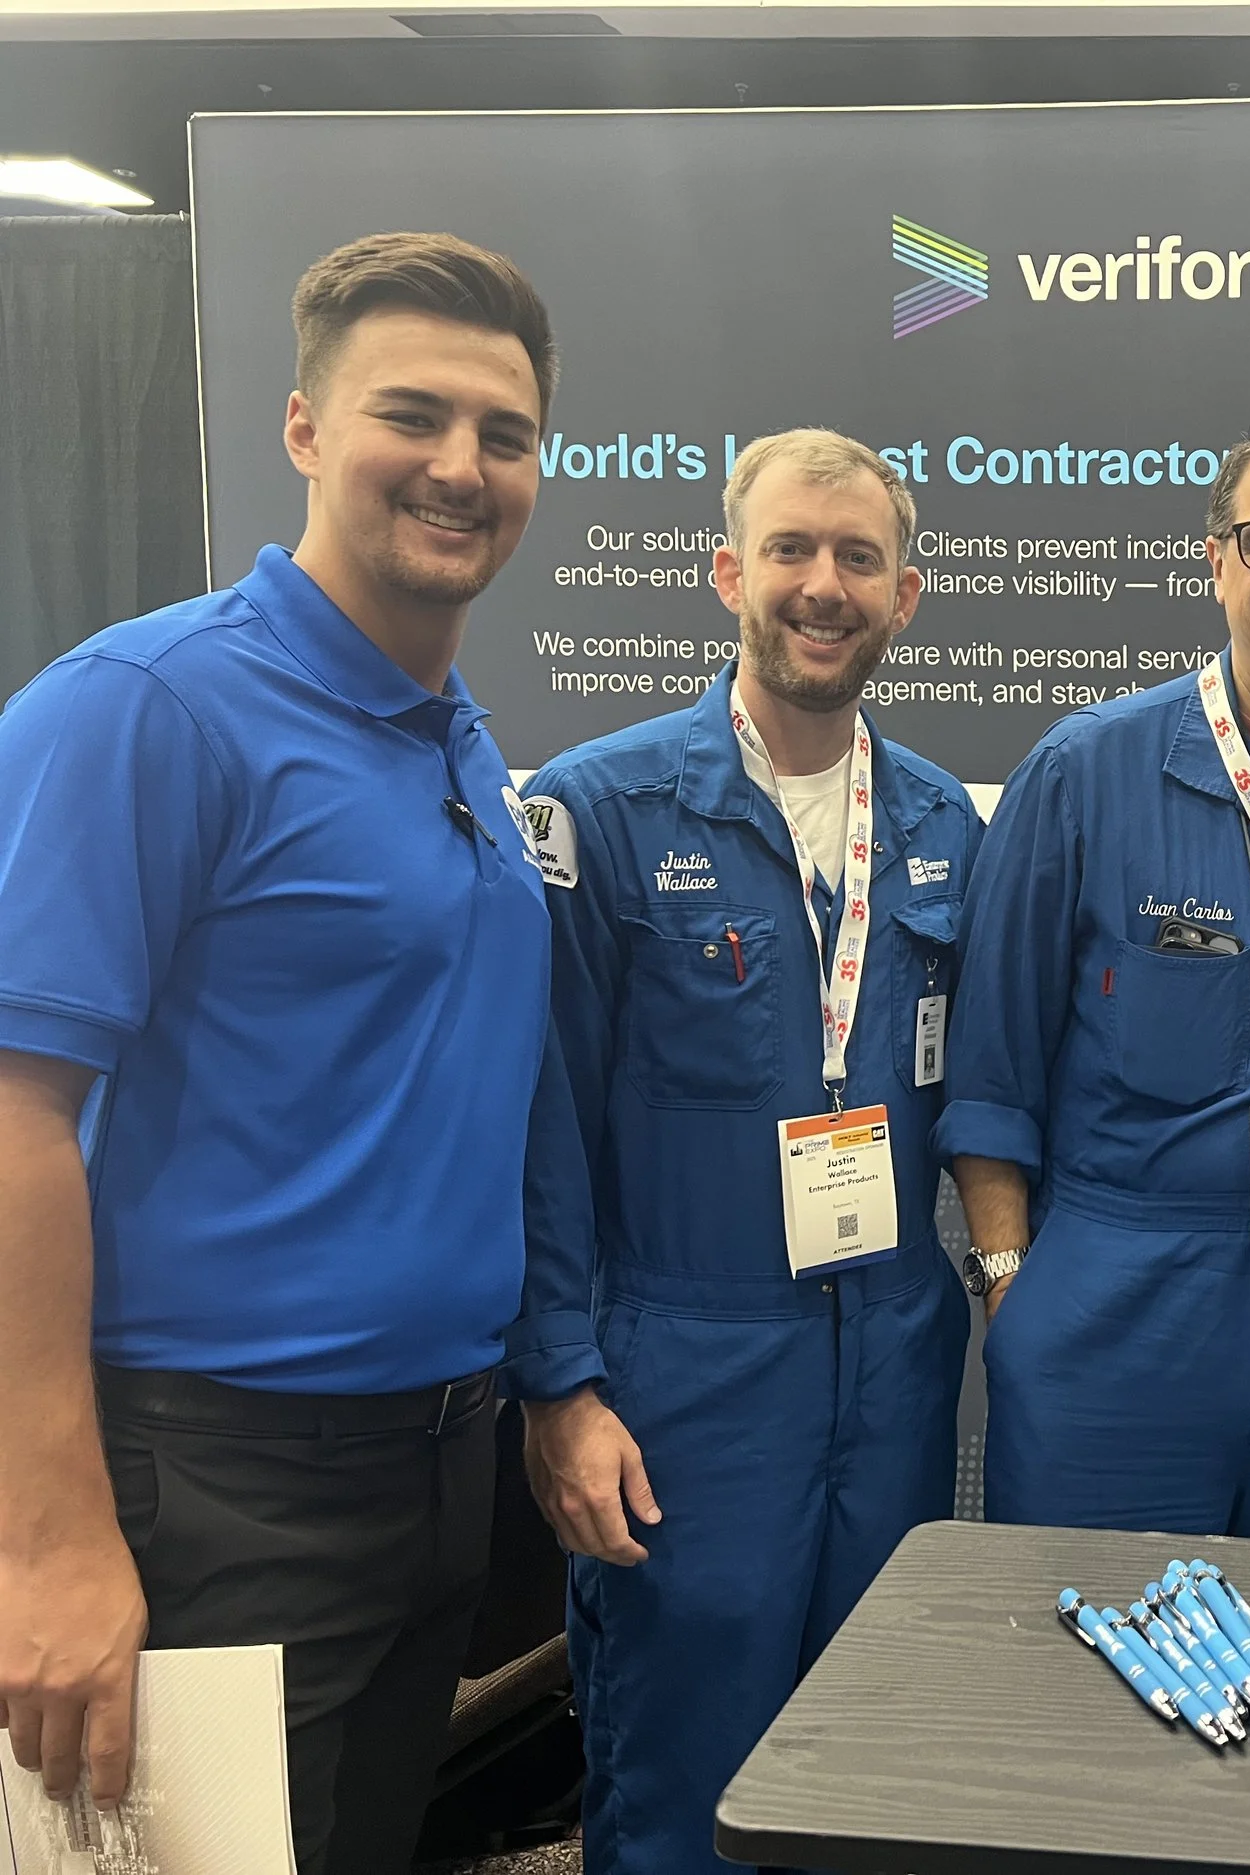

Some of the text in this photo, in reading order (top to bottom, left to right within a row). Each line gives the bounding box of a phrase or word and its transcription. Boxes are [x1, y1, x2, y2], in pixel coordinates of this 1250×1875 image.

[946, 435, 1230, 485] Contracto
[586, 525, 635, 551] Our
[642, 527, 728, 552] solutio
[916, 531, 1008, 558] Clients
[1017, 534, 1118, 564] prevent
[1126, 534, 1207, 560] incide
[554, 562, 699, 588] end-to-end
[1012, 570, 1118, 602] visibility
[533, 631, 575, 656] We
[583, 633, 695, 659] combine
[948, 641, 1003, 668] with
[1013, 644, 1128, 673] personal
[1137, 646, 1220, 671] servic
[551, 666, 654, 697] improve
[861, 680, 984, 706] agement,
[992, 679, 1042, 705] and
[660, 851, 711, 870] Justin
[654, 871, 718, 891] Wallace
[851, 898, 866, 921] 3S
[1139, 895, 1234, 921] Juan Carlos
[840, 959, 857, 982] 3S
[827, 1155, 856, 1168] Justin
[808, 1174, 879, 1194] Enterprise Products
[827, 1168, 857, 1179] Wallace
[833, 1244, 863, 1255] ATTENDEE
